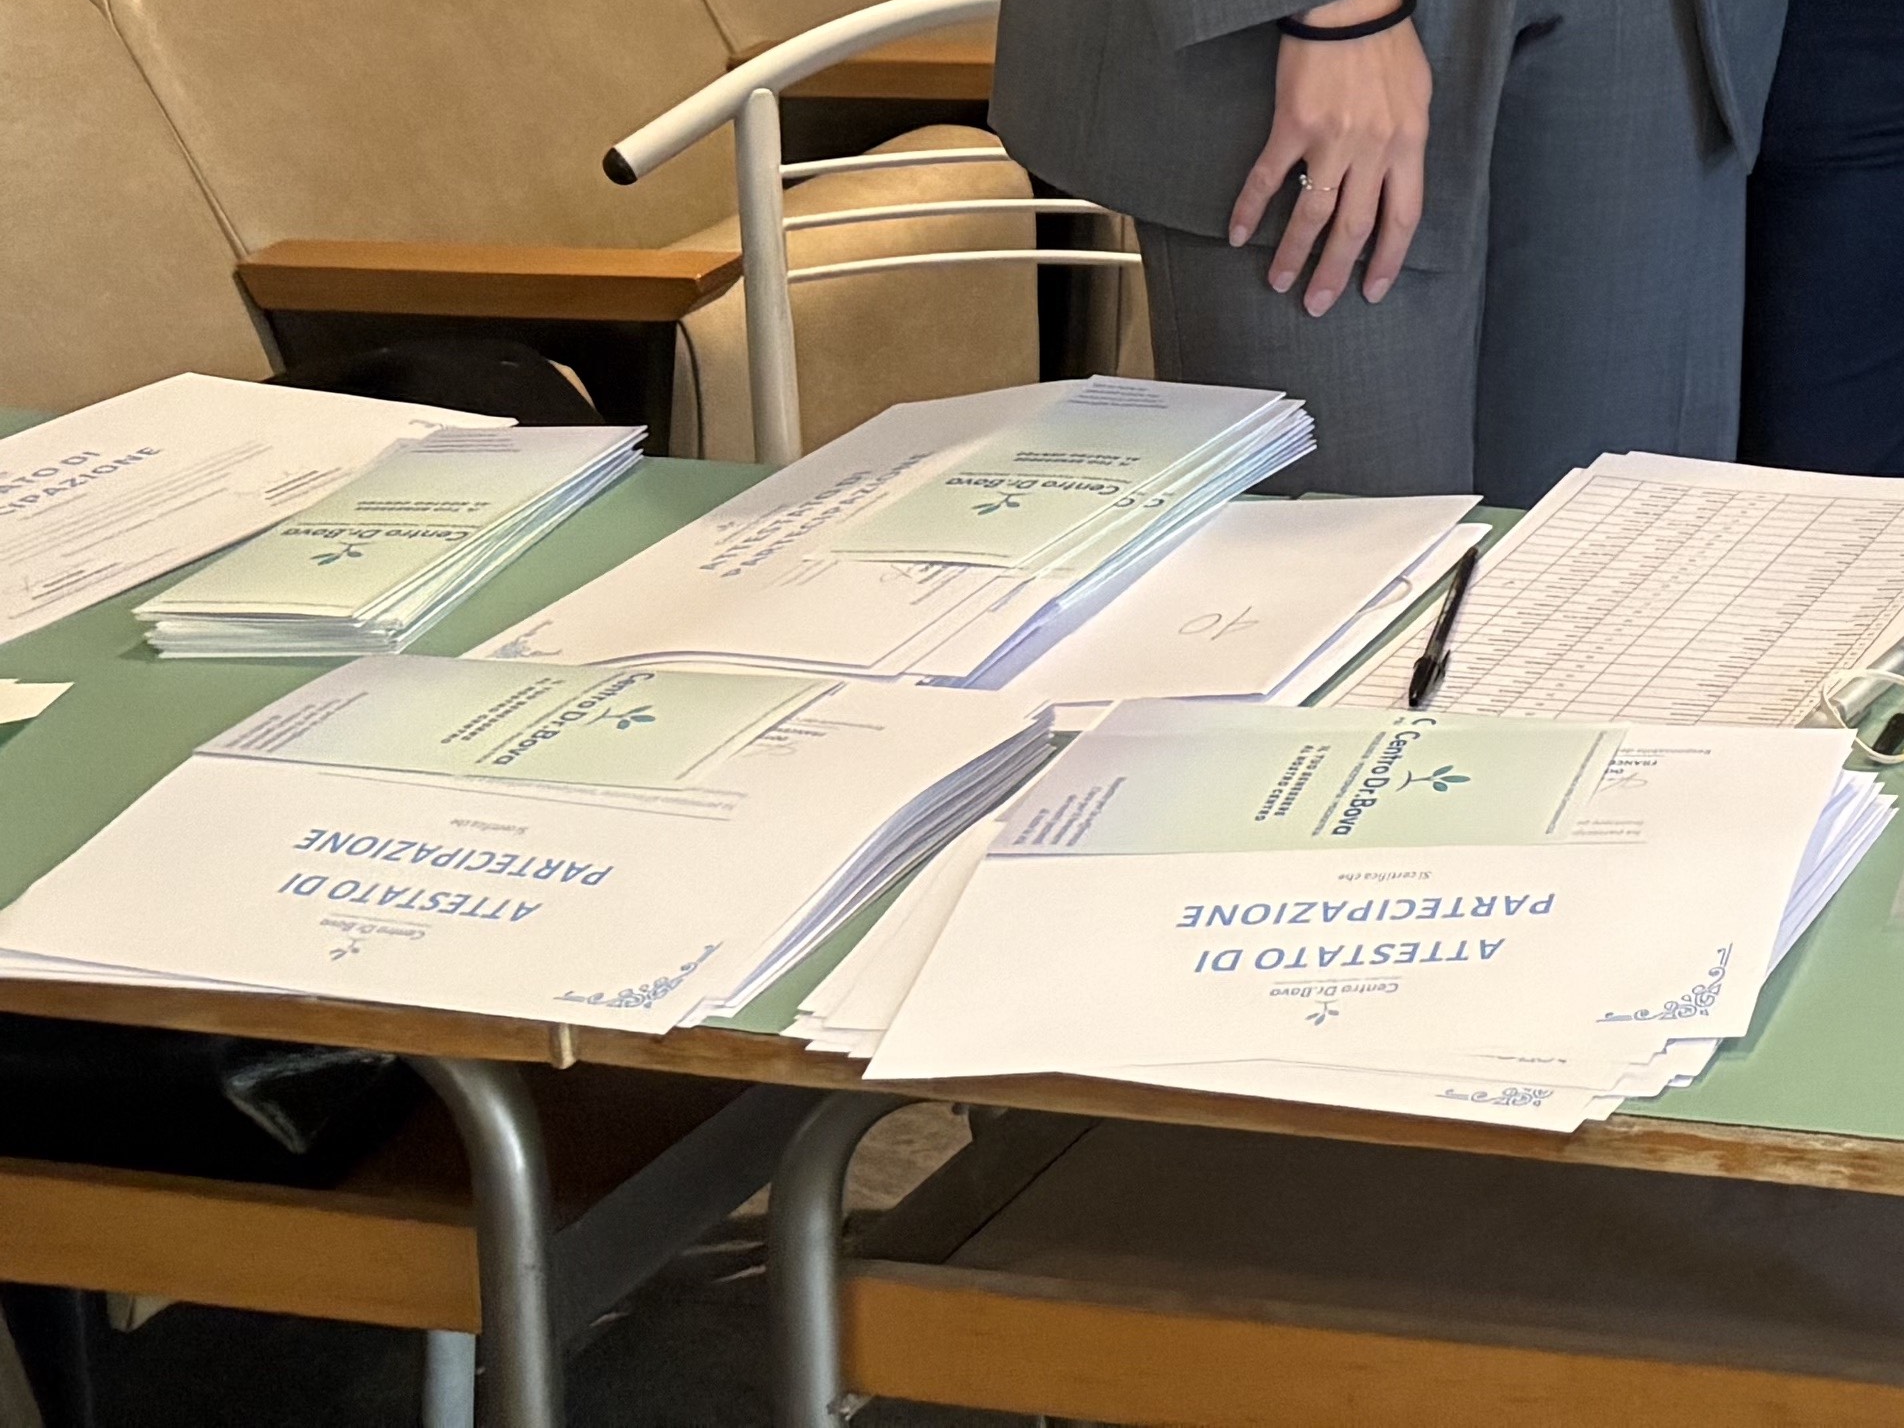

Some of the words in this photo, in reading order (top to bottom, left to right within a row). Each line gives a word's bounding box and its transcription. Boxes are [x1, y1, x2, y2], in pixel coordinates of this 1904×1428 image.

[60, 450, 100, 466] DI
[945, 476, 1039, 490] Dr.Bova
[1041, 479, 1120, 496] Centro
[281, 527, 381, 539] Dr.Bova
[385, 528, 469, 542] Centro
[578, 672, 655, 708] Centro
[492, 711, 587, 766] Dr.Bova
[1371, 731, 1421, 775] Centro
[1331, 777, 1390, 836] Dr.Bova
[293, 828, 615, 887] PARTECIPAZIONE
[278, 872, 329, 896] DI
[327, 879, 543, 923] ATTESTATO
[1175, 893, 1556, 929] PARTECIPAZIONE
[1194, 949, 1244, 973] DI
[1254, 938, 1506, 971] ATTESTATO
[1341, 981, 1399, 994] Centro
